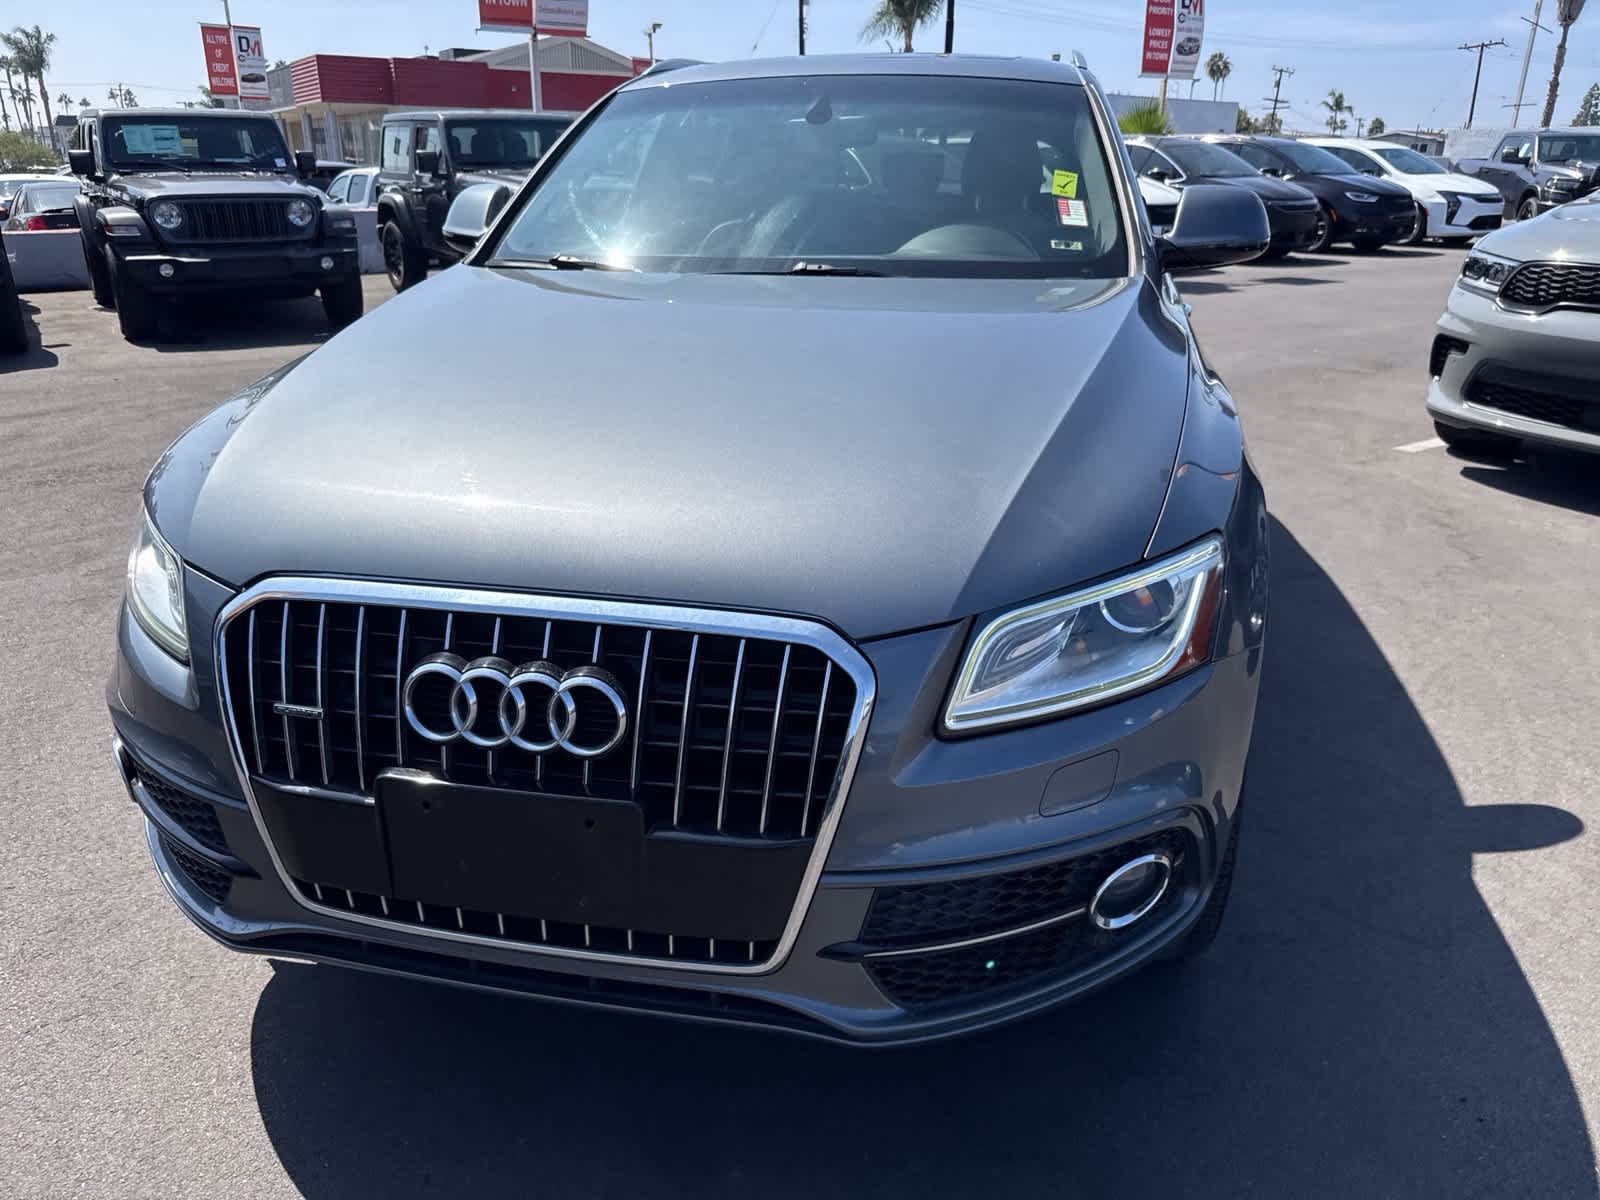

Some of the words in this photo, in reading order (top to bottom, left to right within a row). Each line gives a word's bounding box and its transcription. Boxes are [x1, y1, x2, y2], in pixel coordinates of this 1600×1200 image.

[1148, 6, 1173, 16] PRIORITY
[1149, 27, 1171, 37] LOWEST
[1149, 39, 1169, 49] PRICES
[215, 48, 222, 58] OF
[212, 63, 230, 73] CREDIT
[211, 76, 235, 87] WELCOME
